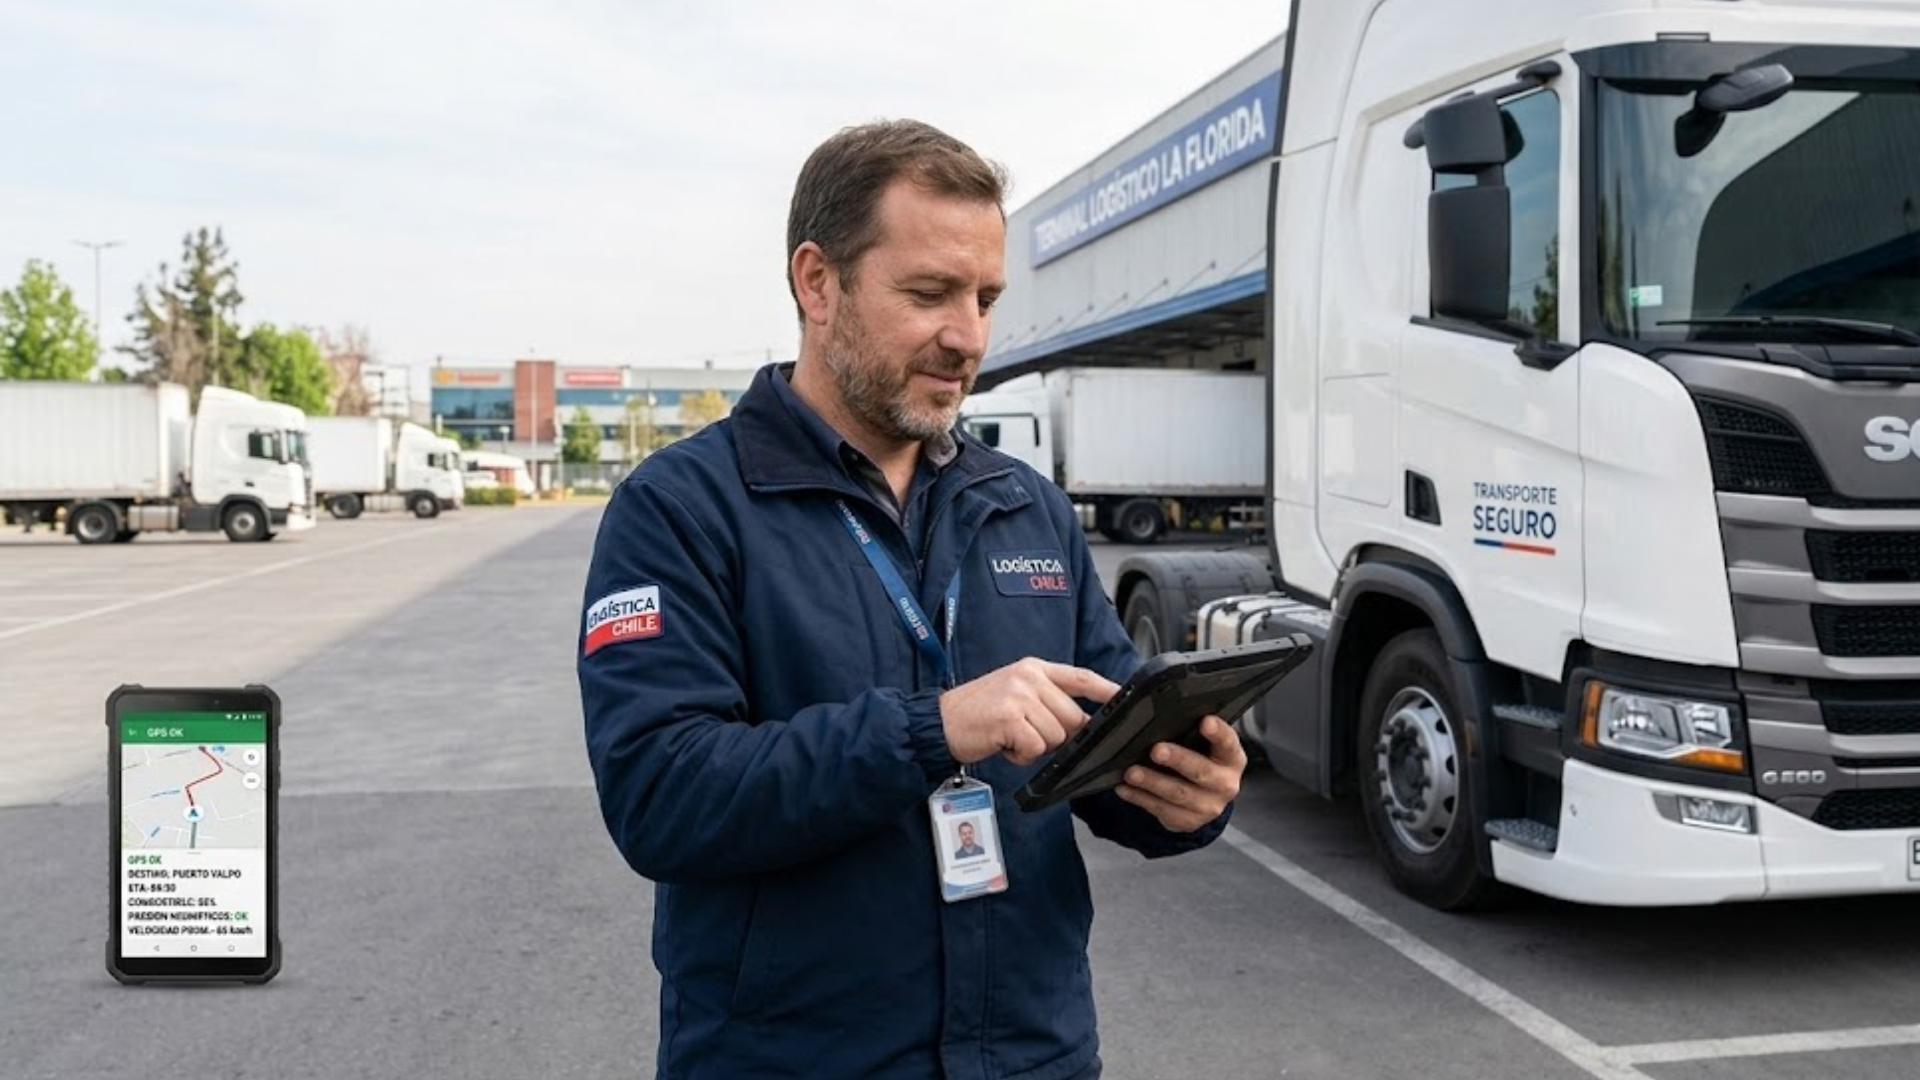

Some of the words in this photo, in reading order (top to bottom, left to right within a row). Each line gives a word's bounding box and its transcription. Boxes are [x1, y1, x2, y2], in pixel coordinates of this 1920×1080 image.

[1089, 157, 1160, 227] LOGÍSTICO
[1160, 144, 1184, 190] LA
[1185, 97, 1267, 177] FLORIDA
[1863, 415, 1920, 462] S
[1473, 482, 1557, 505] TRANSPORTE
[1473, 505, 1556, 539] SEGURO
[992, 555, 1064, 573] LOGÍSTICA
[612, 615, 657, 637] CHILE
[146, 727, 168, 738] GPS
[168, 727, 184, 738] OK
[127, 855, 147, 865] GPS
[148, 855, 162, 865] OK
[172, 869, 209, 879] PUERTO
[210, 869, 241, 879] VALPO
[234, 911, 249, 921] OK
